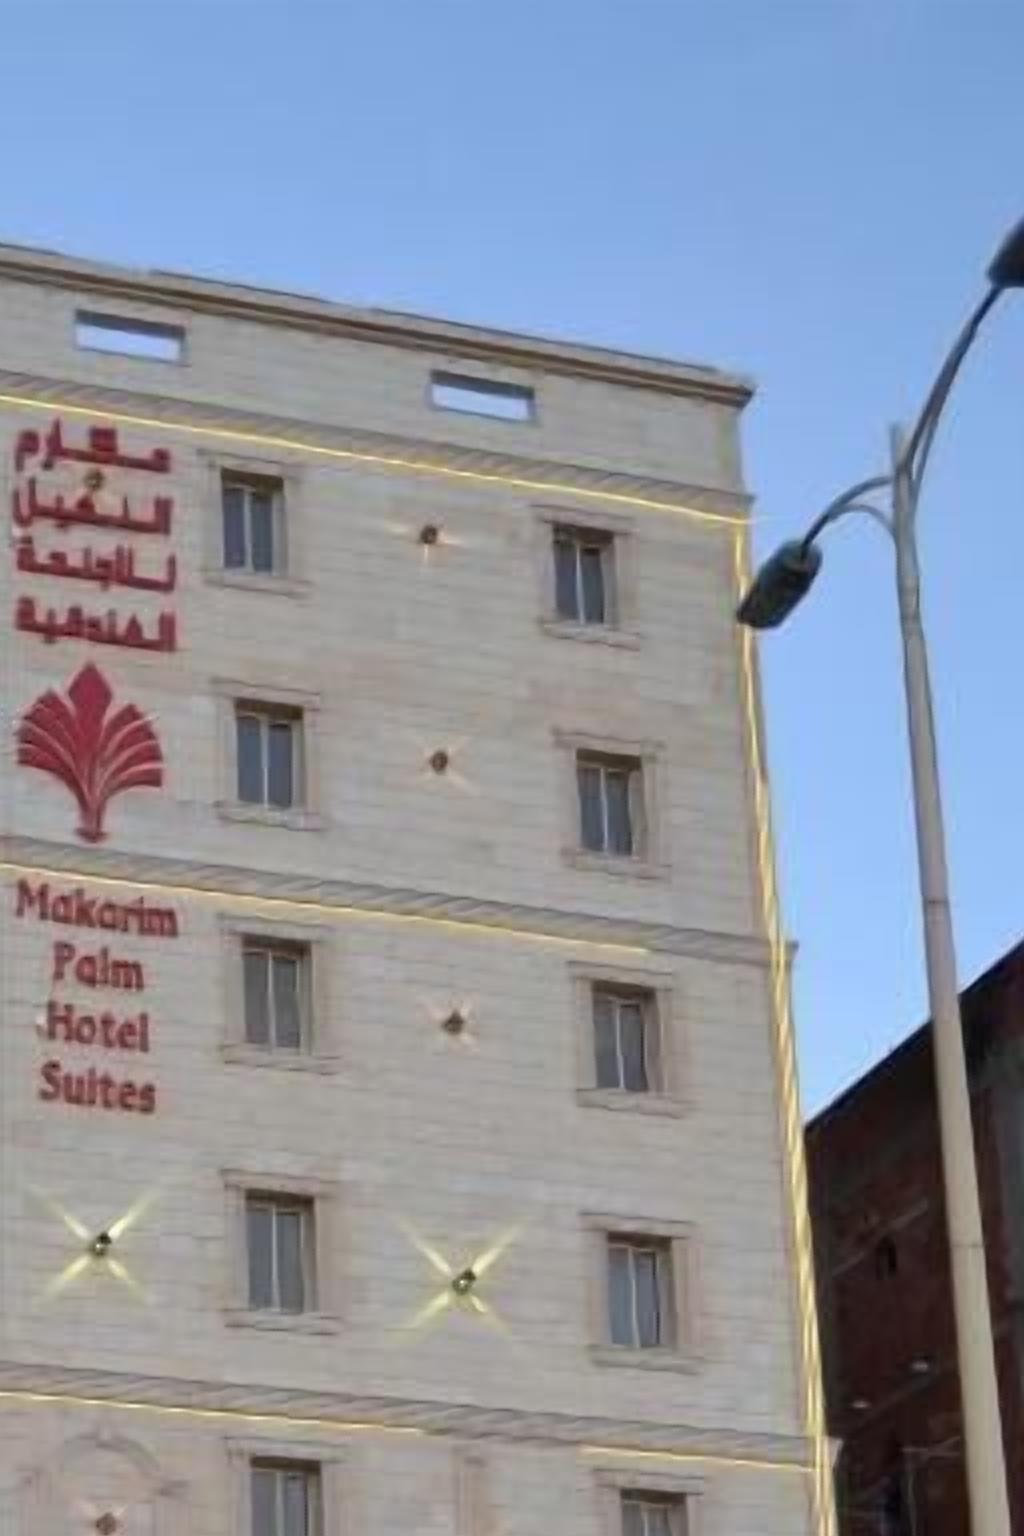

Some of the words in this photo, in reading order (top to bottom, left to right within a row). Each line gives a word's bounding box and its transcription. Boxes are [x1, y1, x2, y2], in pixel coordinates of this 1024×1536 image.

[14, 417, 171, 473] مكارم
[12, 477, 173, 535] النخيل
[15, 880, 179, 938] Makarim
[52, 941, 144, 992] Palm
[46, 1000, 150, 1053] Hotel
[38, 1060, 157, 1114] Suites
